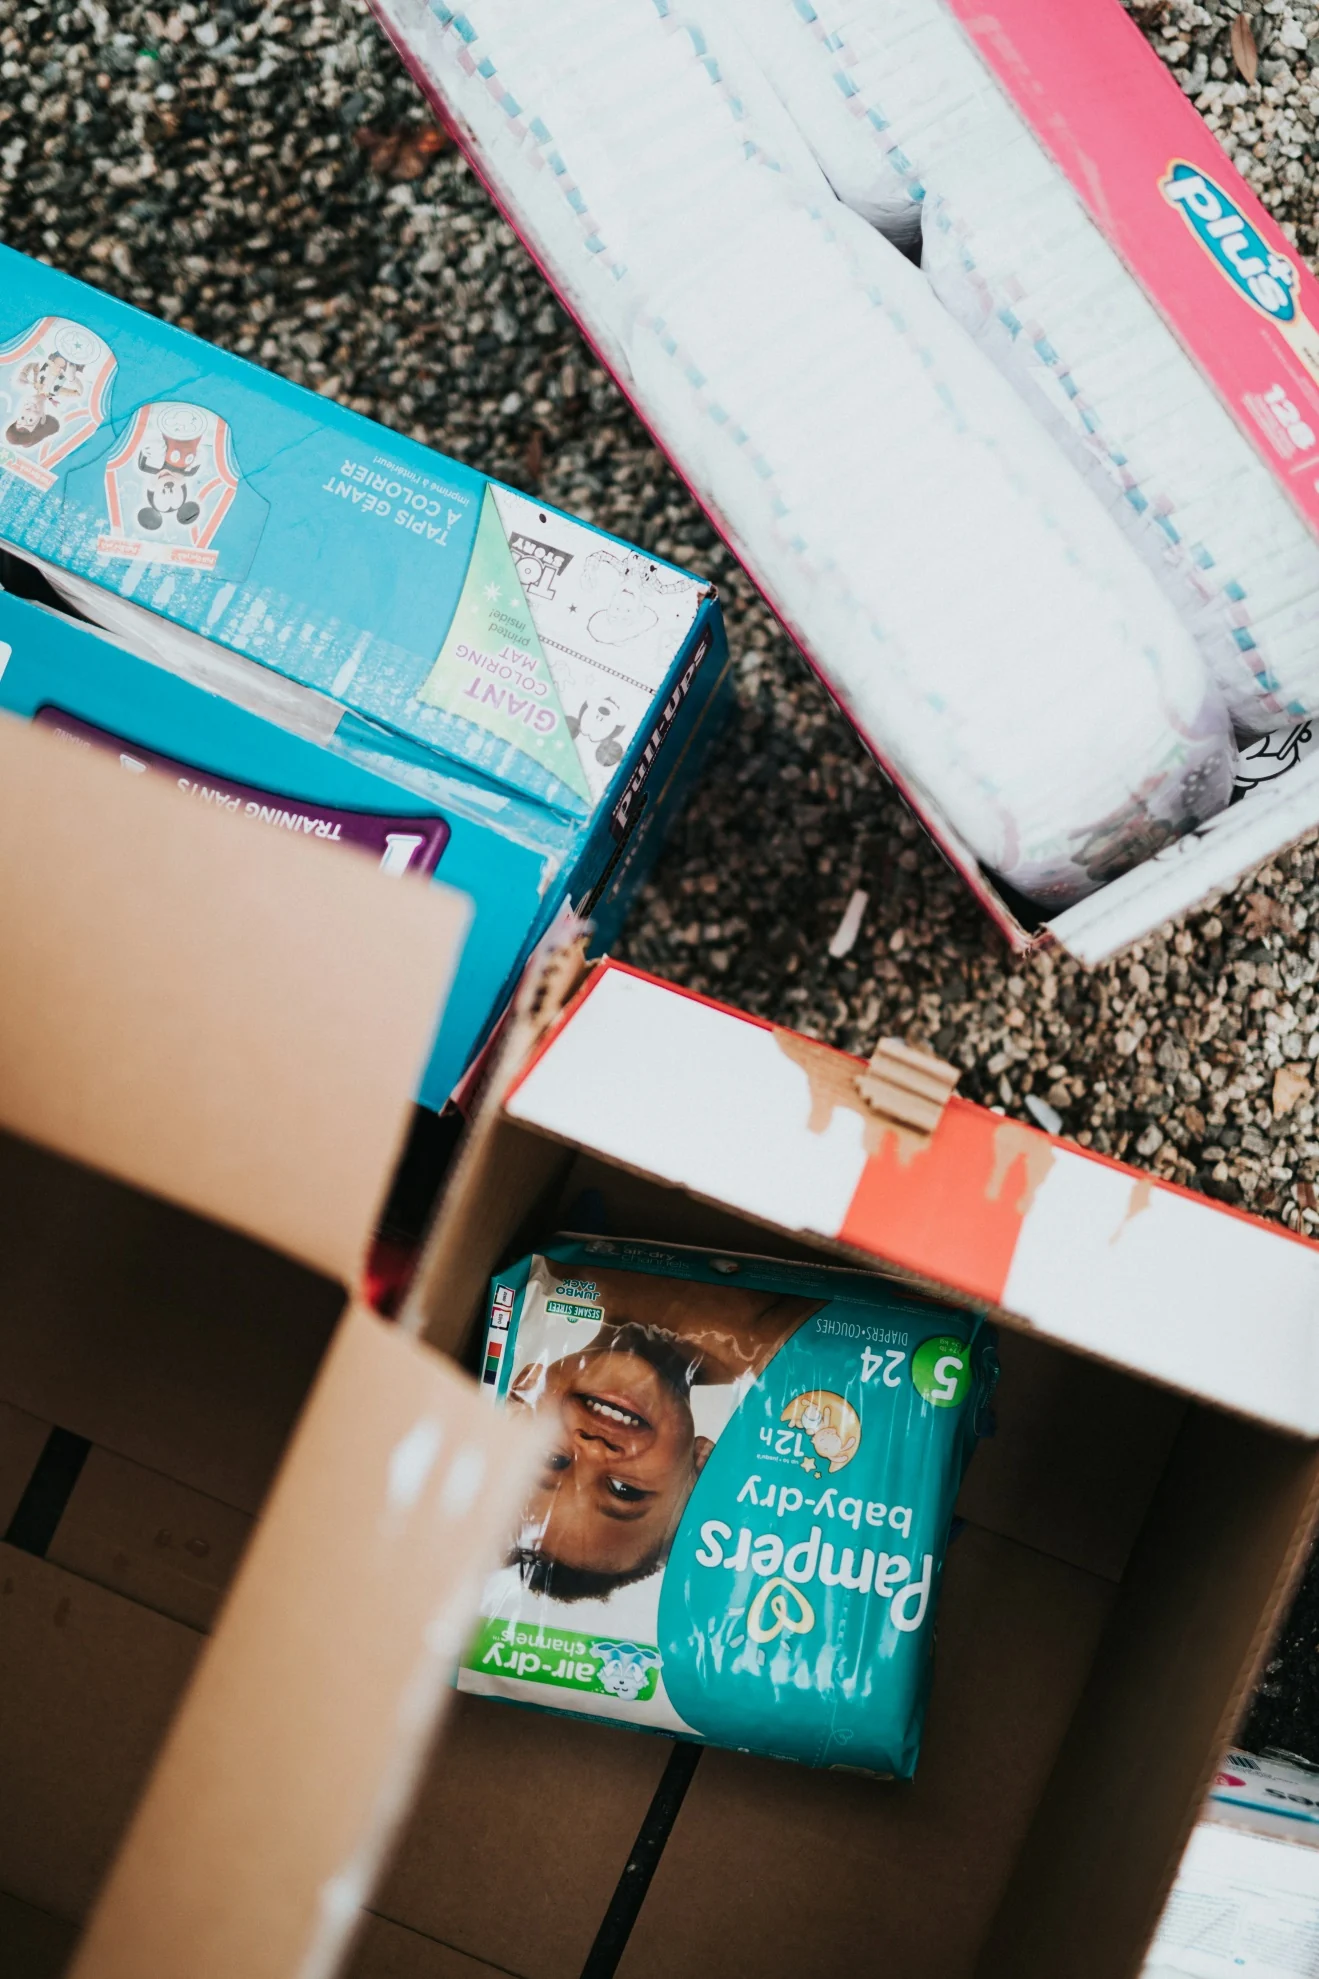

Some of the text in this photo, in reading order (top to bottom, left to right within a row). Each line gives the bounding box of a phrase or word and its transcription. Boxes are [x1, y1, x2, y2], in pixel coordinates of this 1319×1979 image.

[322, 476, 449, 546] TAPIS GÉANT
[340, 459, 463, 530] À COLORIER
[429, 482, 471, 507] imprimé
[511, 537, 566, 568] STORY
[511, 549, 557, 600] TO
[488, 608, 527, 633] inside!
[488, 621, 531, 648] printed
[455, 644, 548, 697] COLORING
[498, 646, 538, 672] MAT
[463, 677, 557, 733] GIANT
[176, 777, 343, 841] TRAINING PANTS
[555, 1286, 600, 1301] JUMBO
[562, 1278, 596, 1291] PACK
[548, 1301, 601, 1320] SESAME STREET
[860, 1345, 906, 1388] 24
[931, 1356, 964, 1401] 5
[736, 1474, 913, 1539] baby-dry
[695, 1519, 934, 1632] Pampers
[482, 1642, 596, 1683] air-dry
